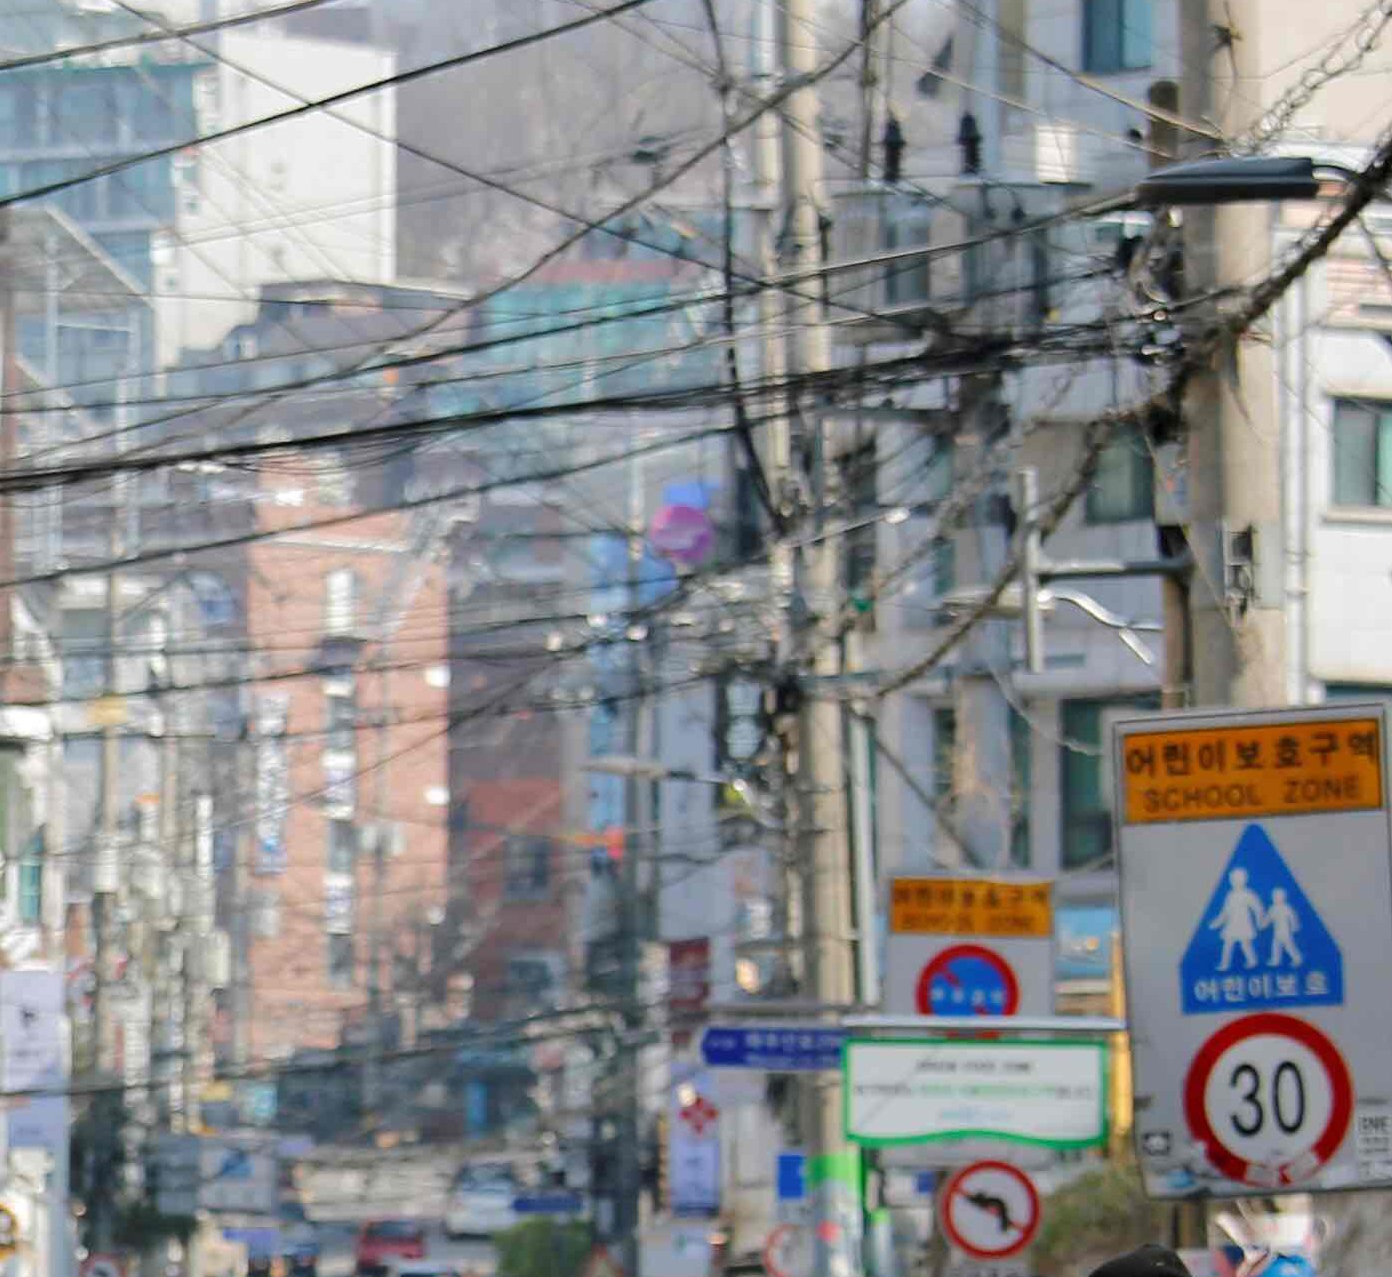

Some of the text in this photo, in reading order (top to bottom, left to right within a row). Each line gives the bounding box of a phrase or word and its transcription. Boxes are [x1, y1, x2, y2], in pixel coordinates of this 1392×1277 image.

[1124, 731, 1377, 778] 어린이보호구역
[1143, 775, 1360, 813] SCHOOL ZONE
[1193, 971, 1328, 1002] 어린이보호
[1229, 1061, 1306, 1137] 30
